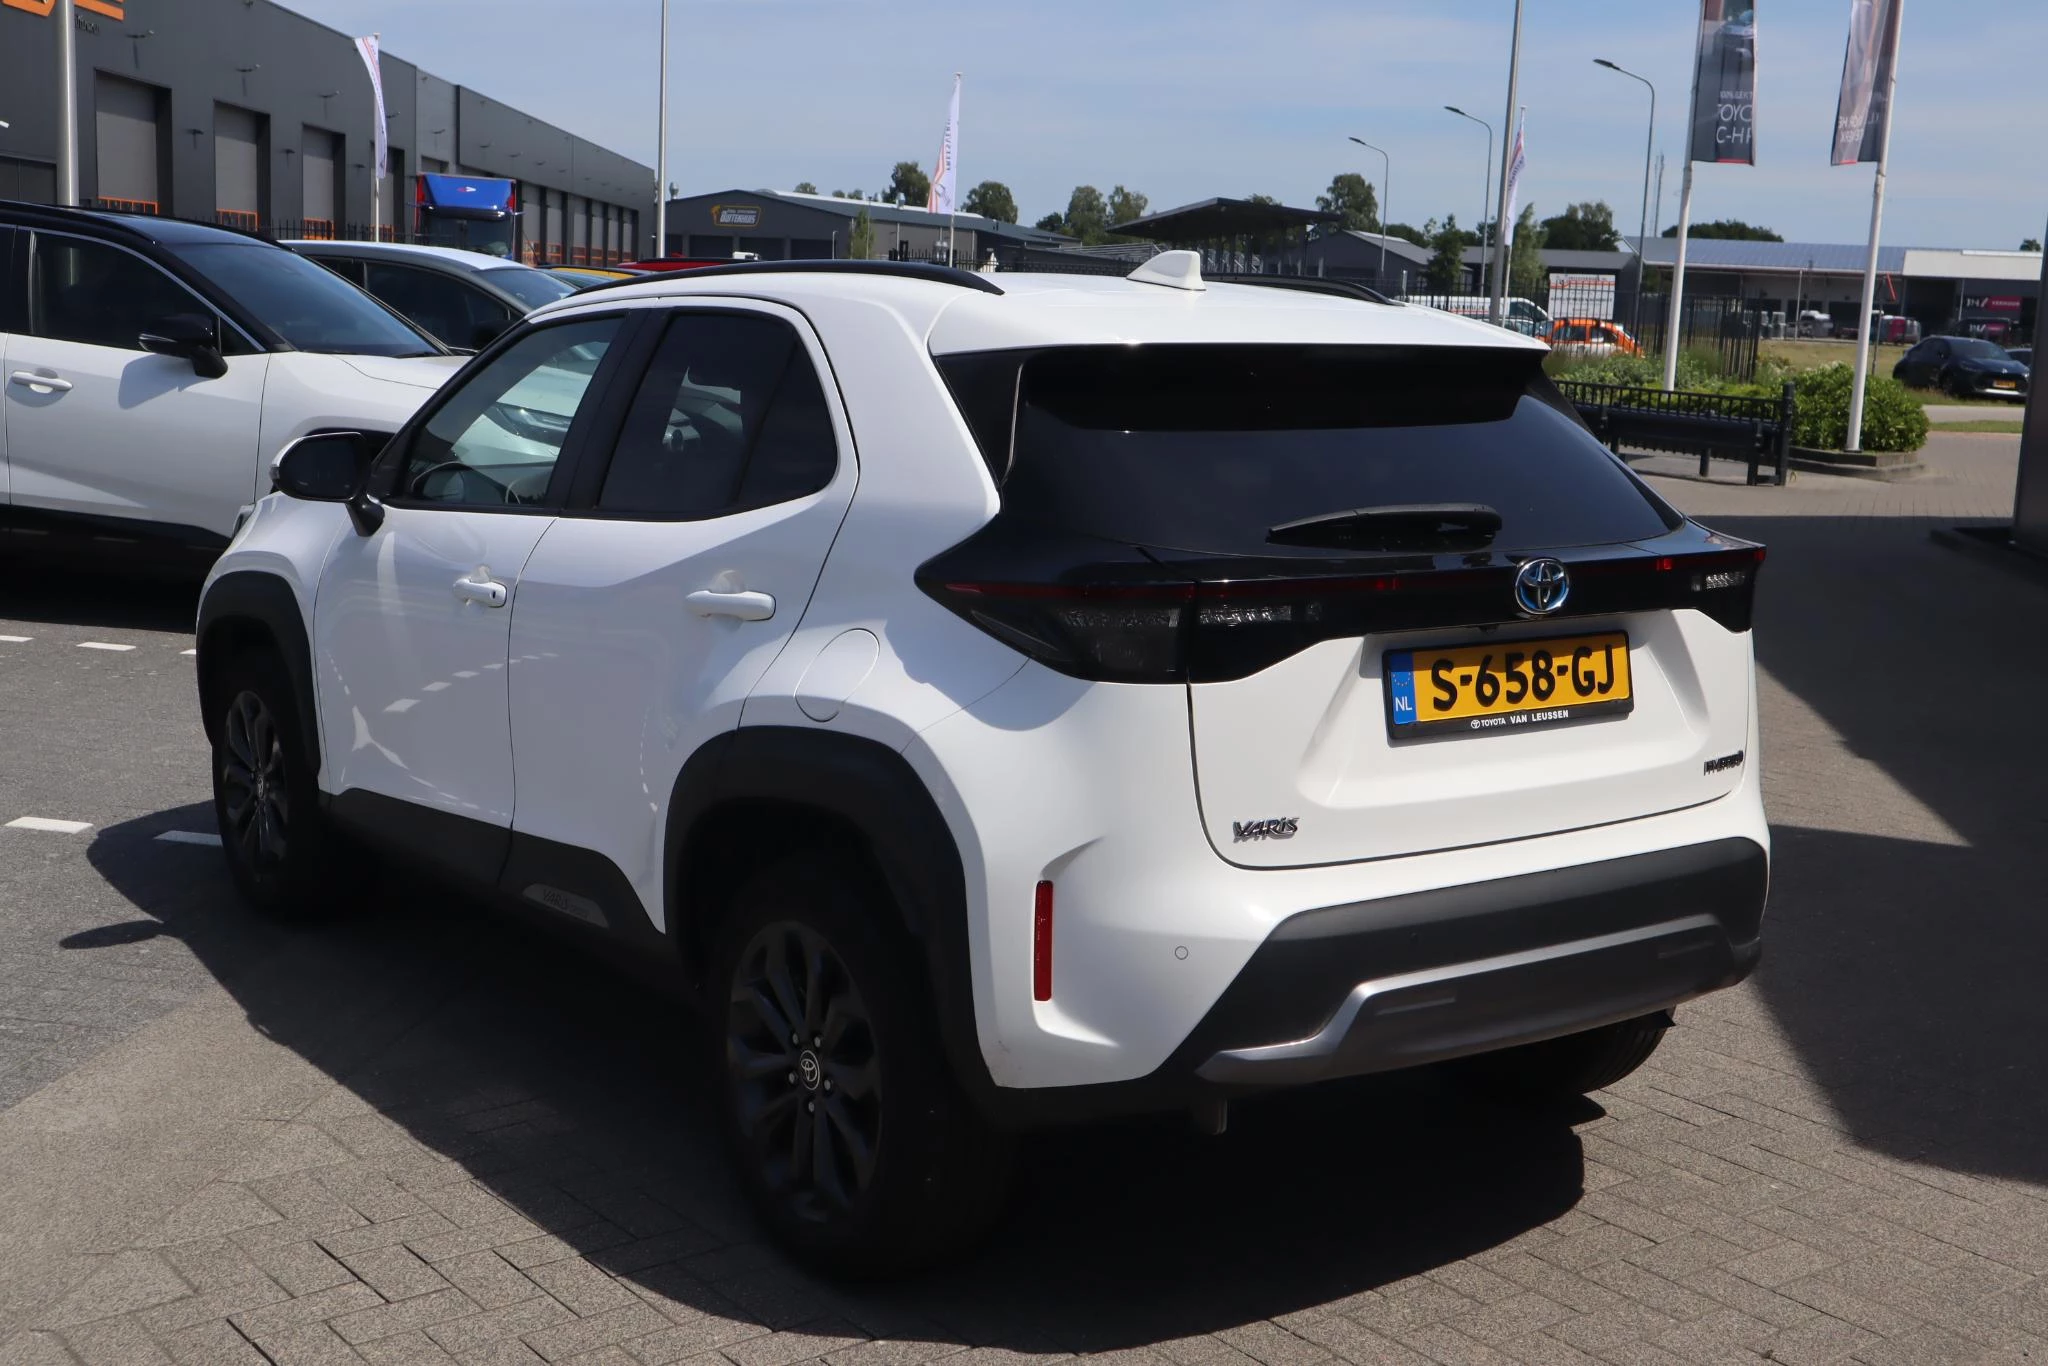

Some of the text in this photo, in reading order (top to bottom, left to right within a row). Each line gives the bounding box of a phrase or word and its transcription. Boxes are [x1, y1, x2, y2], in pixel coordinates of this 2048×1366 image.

[1431, 644, 1614, 711] S-658-GJ
[1395, 696, 1412, 712] NL
[1481, 710, 1569, 728] TOYOTA VAN LEUSSEN
